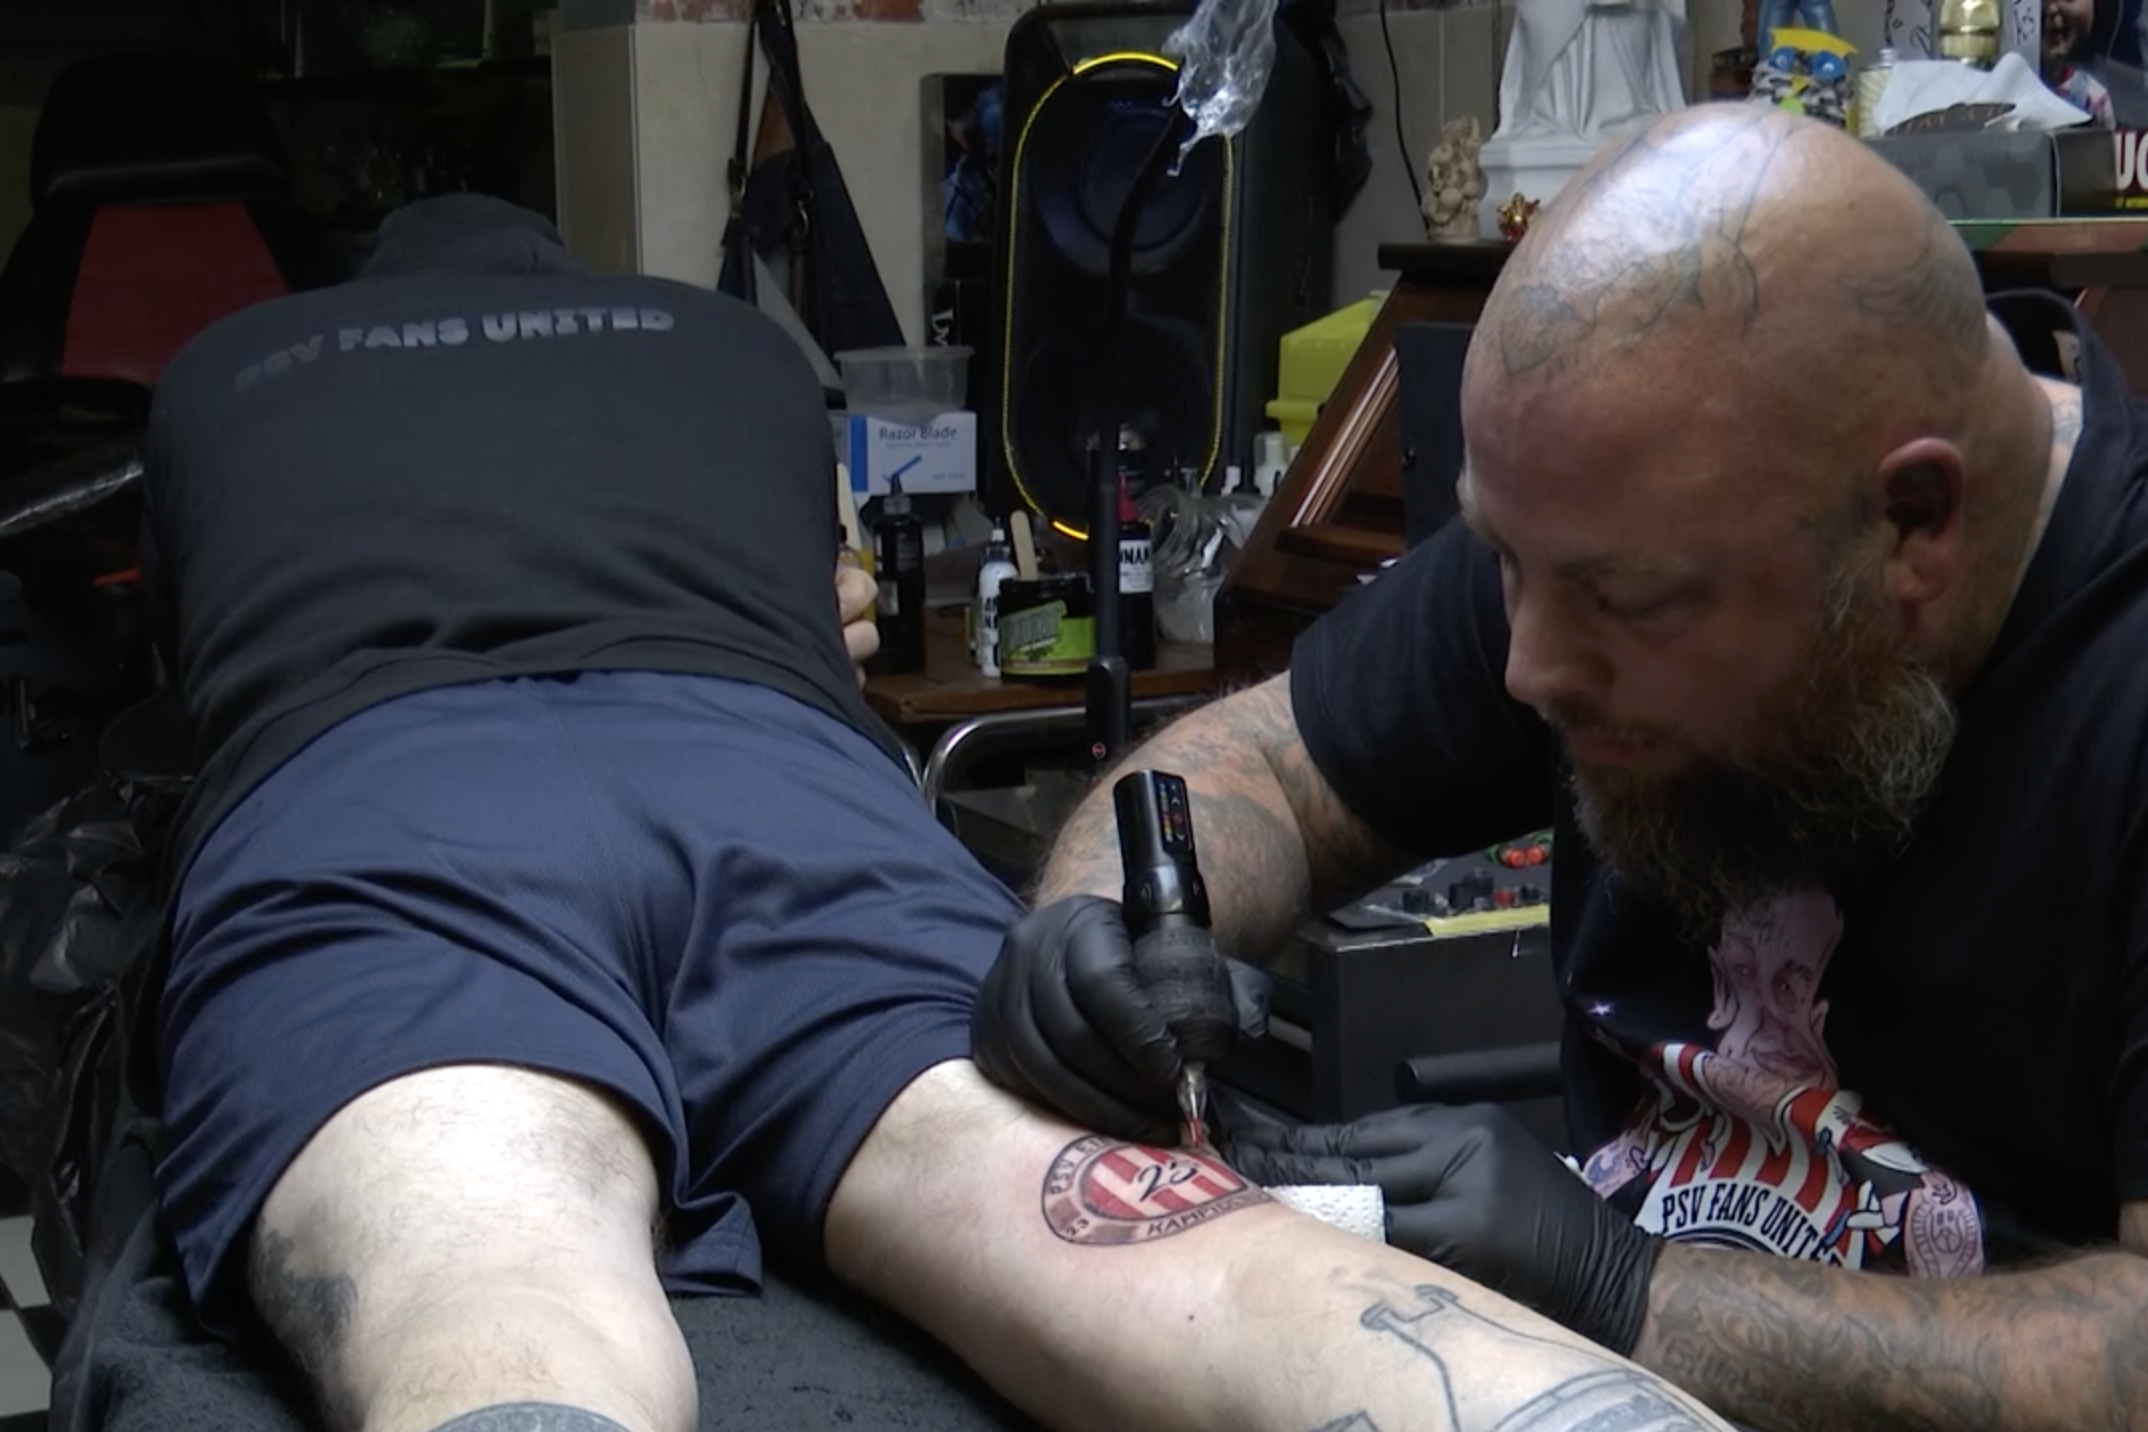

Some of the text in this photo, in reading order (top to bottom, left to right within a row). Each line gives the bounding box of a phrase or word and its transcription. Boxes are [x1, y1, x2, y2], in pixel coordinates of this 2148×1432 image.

[338, 317, 470, 351] FANS
[482, 307, 675, 343] UNITED
[879, 425, 958, 440] Razor Blade
[1662, 1184, 1707, 1236] PSV
[1706, 1182, 1771, 1227] FANS
